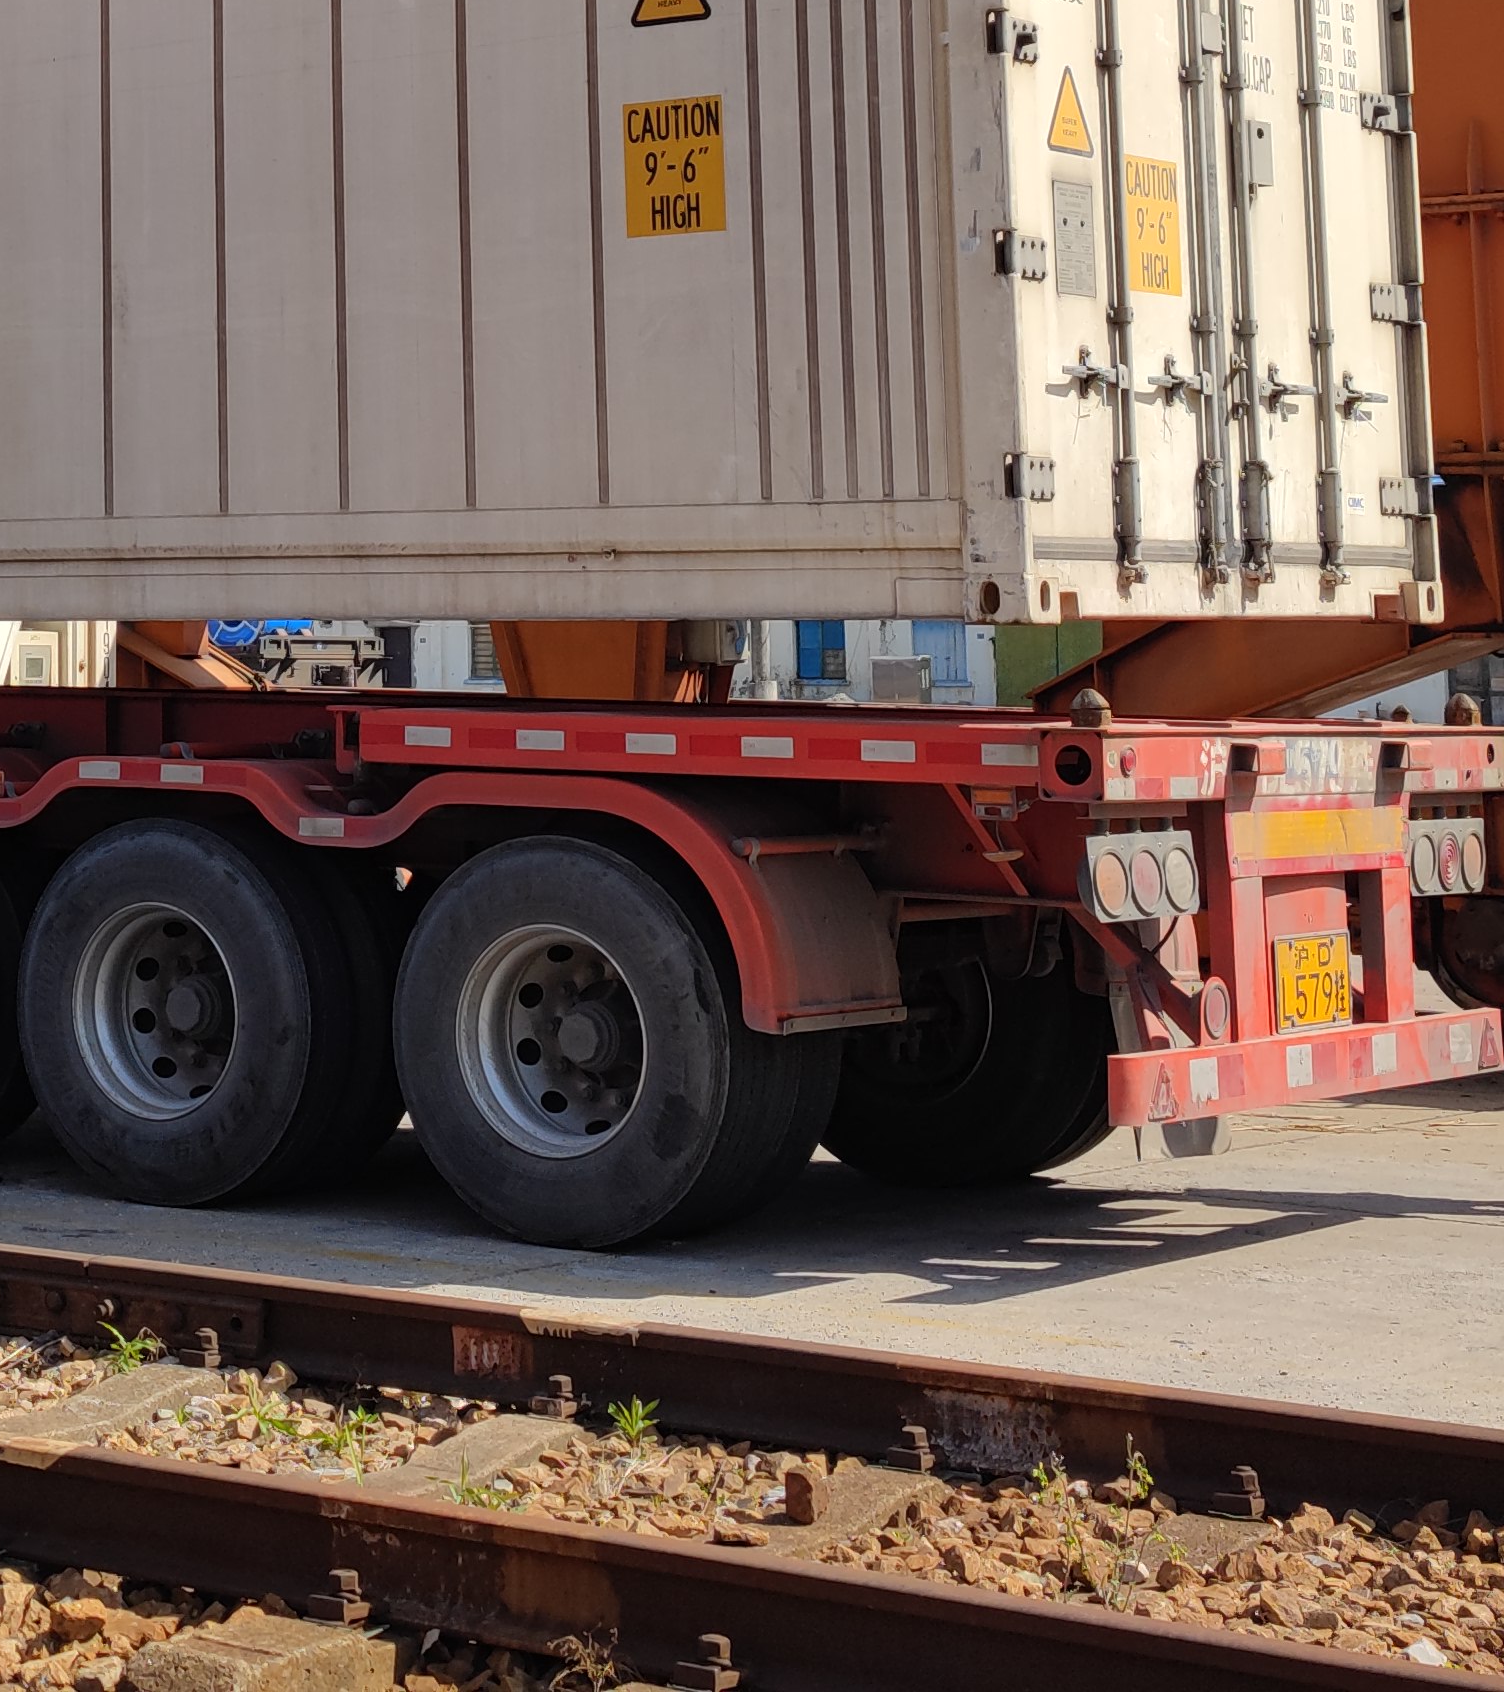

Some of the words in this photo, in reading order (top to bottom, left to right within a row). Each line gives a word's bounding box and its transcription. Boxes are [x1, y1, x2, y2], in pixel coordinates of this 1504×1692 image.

[1341, 1, 1355, 23] LBS
[1342, 26, 1352, 46] KG
[1243, 51, 1275, 95] U.CAP.
[1343, 48, 1357, 69] LBS
[626, 99, 720, 144] CAUTION
[1125, 160, 1177, 203] CAUTION
[650, 191, 701, 231] HIGH
[1141, 252, 1170, 290] HIGH
[1282, 969, 1346, 1022] L579挂
